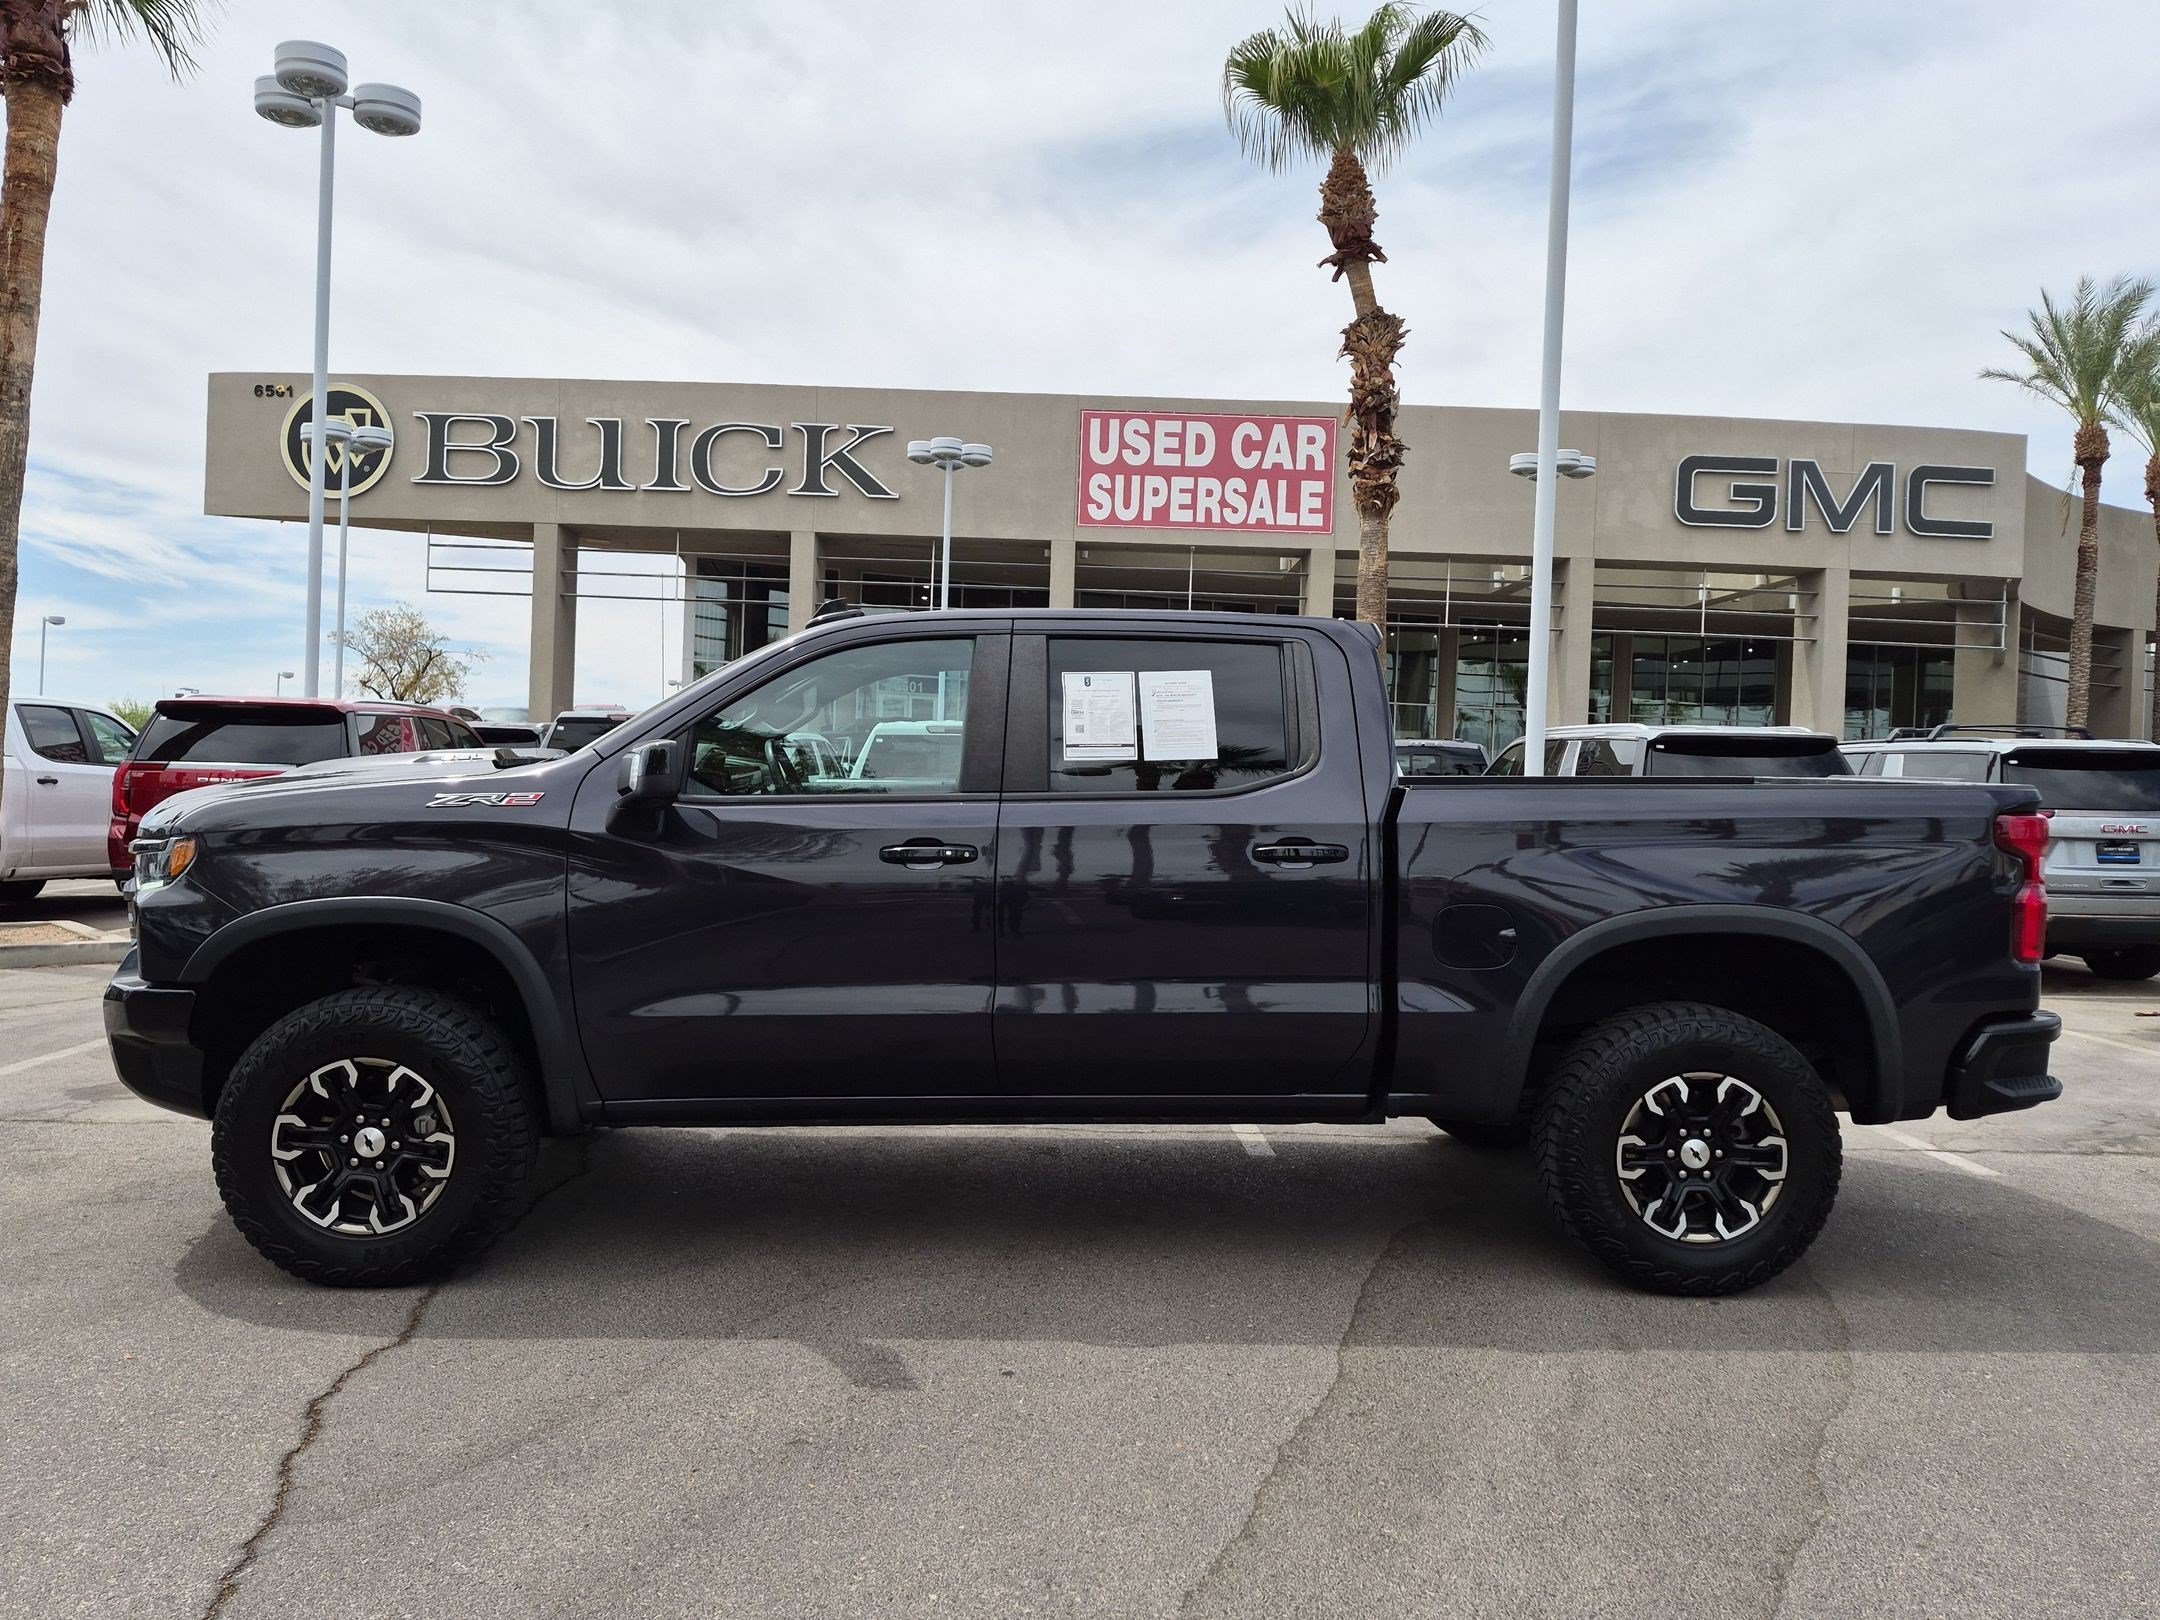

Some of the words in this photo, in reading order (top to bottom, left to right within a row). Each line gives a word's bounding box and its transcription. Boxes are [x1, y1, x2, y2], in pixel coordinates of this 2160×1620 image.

[411, 411, 899, 498] BUICK
[1089, 418, 1216, 467] USED
[1231, 421, 1327, 471] CAR
[1087, 472, 1325, 527] SUPERSALE
[1674, 454, 1996, 539] GMC
[425, 792, 545, 808] ZR2
[2100, 823, 2149, 834] GMC
